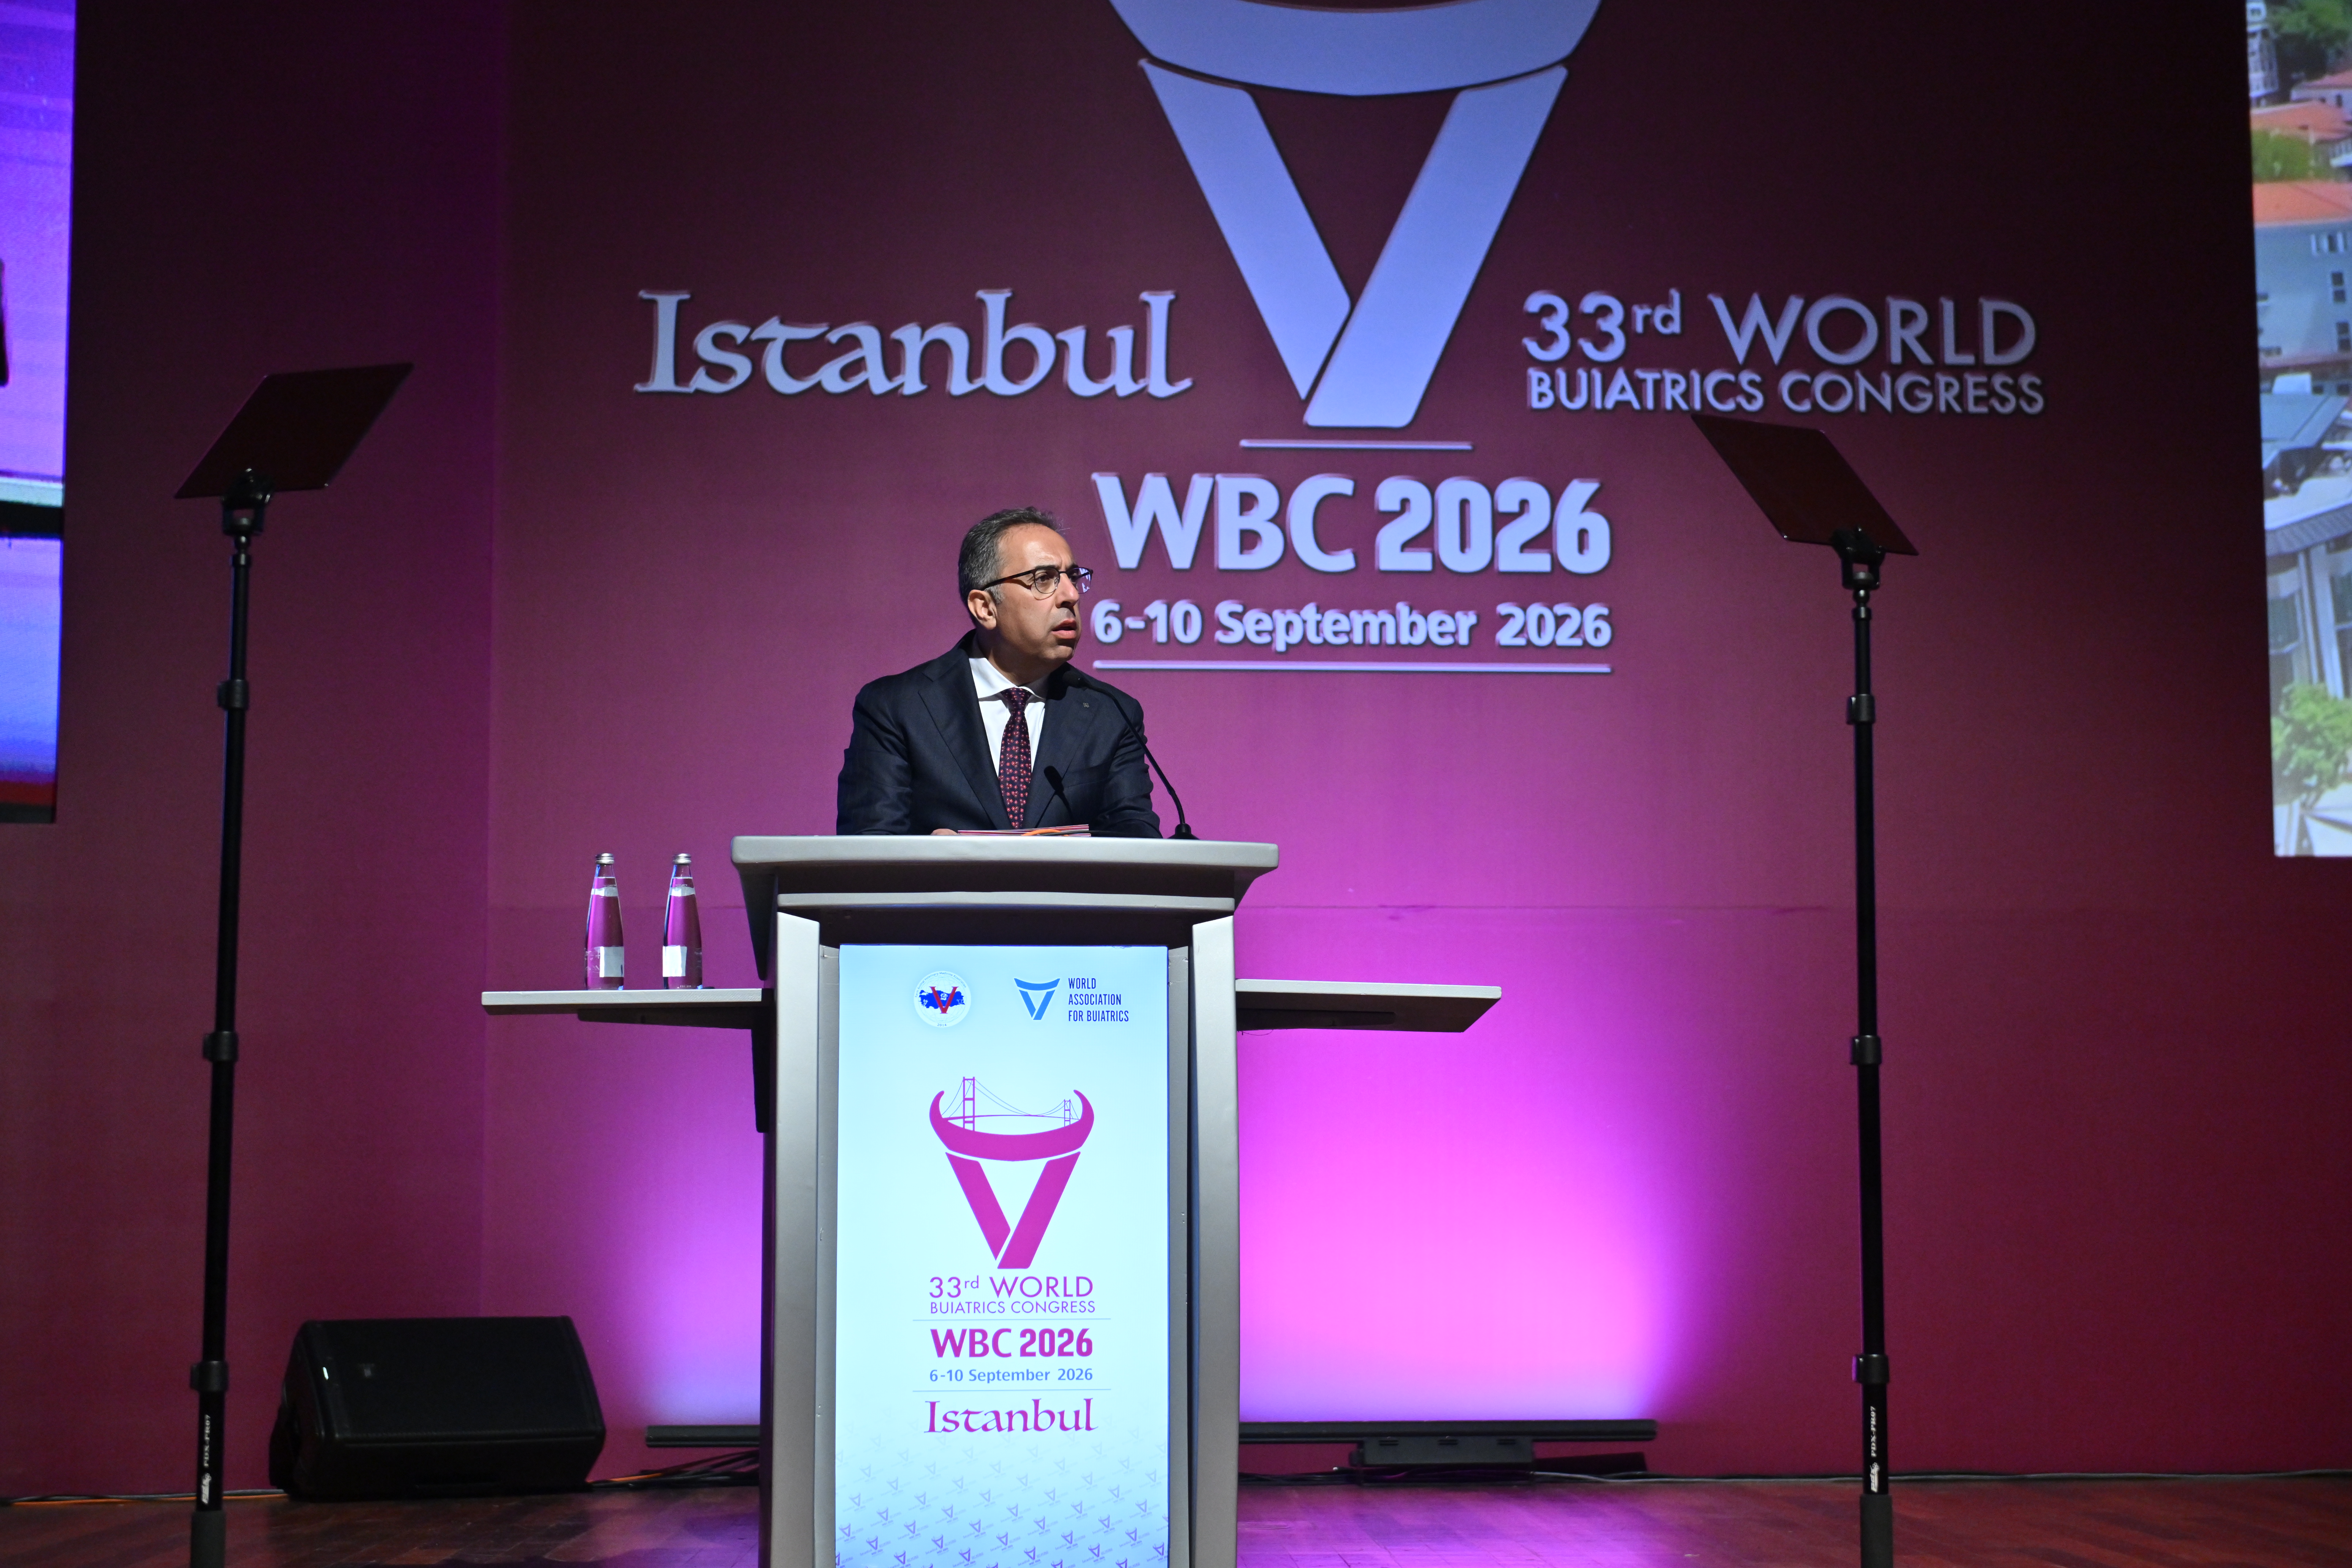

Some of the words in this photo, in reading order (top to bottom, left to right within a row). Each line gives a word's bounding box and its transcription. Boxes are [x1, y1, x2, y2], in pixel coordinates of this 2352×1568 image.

[1522, 288, 1681, 362] 33rd
[1707, 292, 2036, 365] WORLD
[634, 289, 1193, 398] Istanbul
[1527, 367, 1764, 412] BUIATRICS
[1778, 369, 2045, 414] CONGRESS
[1091, 472, 1356, 572] WBC
[1375, 475, 1611, 574] 2026
[1091, 599, 1202, 643] 6-10
[1215, 599, 1477, 652] September
[1495, 602, 1612, 647] 2026
[953, 975, 966, 988] Association
[1068, 978, 1096, 989] WORLD
[1068, 994, 1121, 1005] ASSOCIATION
[1068, 1010, 1083, 1022] FOR
[1087, 1010, 1129, 1022] BUIATRICS
[929, 1275, 979, 1298] 33rd
[989, 1276, 1093, 1298] WORLD
[931, 1301, 1005, 1314] BUIATRICS
[1011, 1301, 1095, 1314] CONGRESS
[930, 1328, 1012, 1358] WBC
[1020, 1328, 1093, 1357] 2026
[929, 1369, 963, 1382] 6-10
[969, 1369, 1050, 1384] September
[1057, 1368, 1093, 1380] 2026
[924, 1398, 1099, 1433] Istanbul
